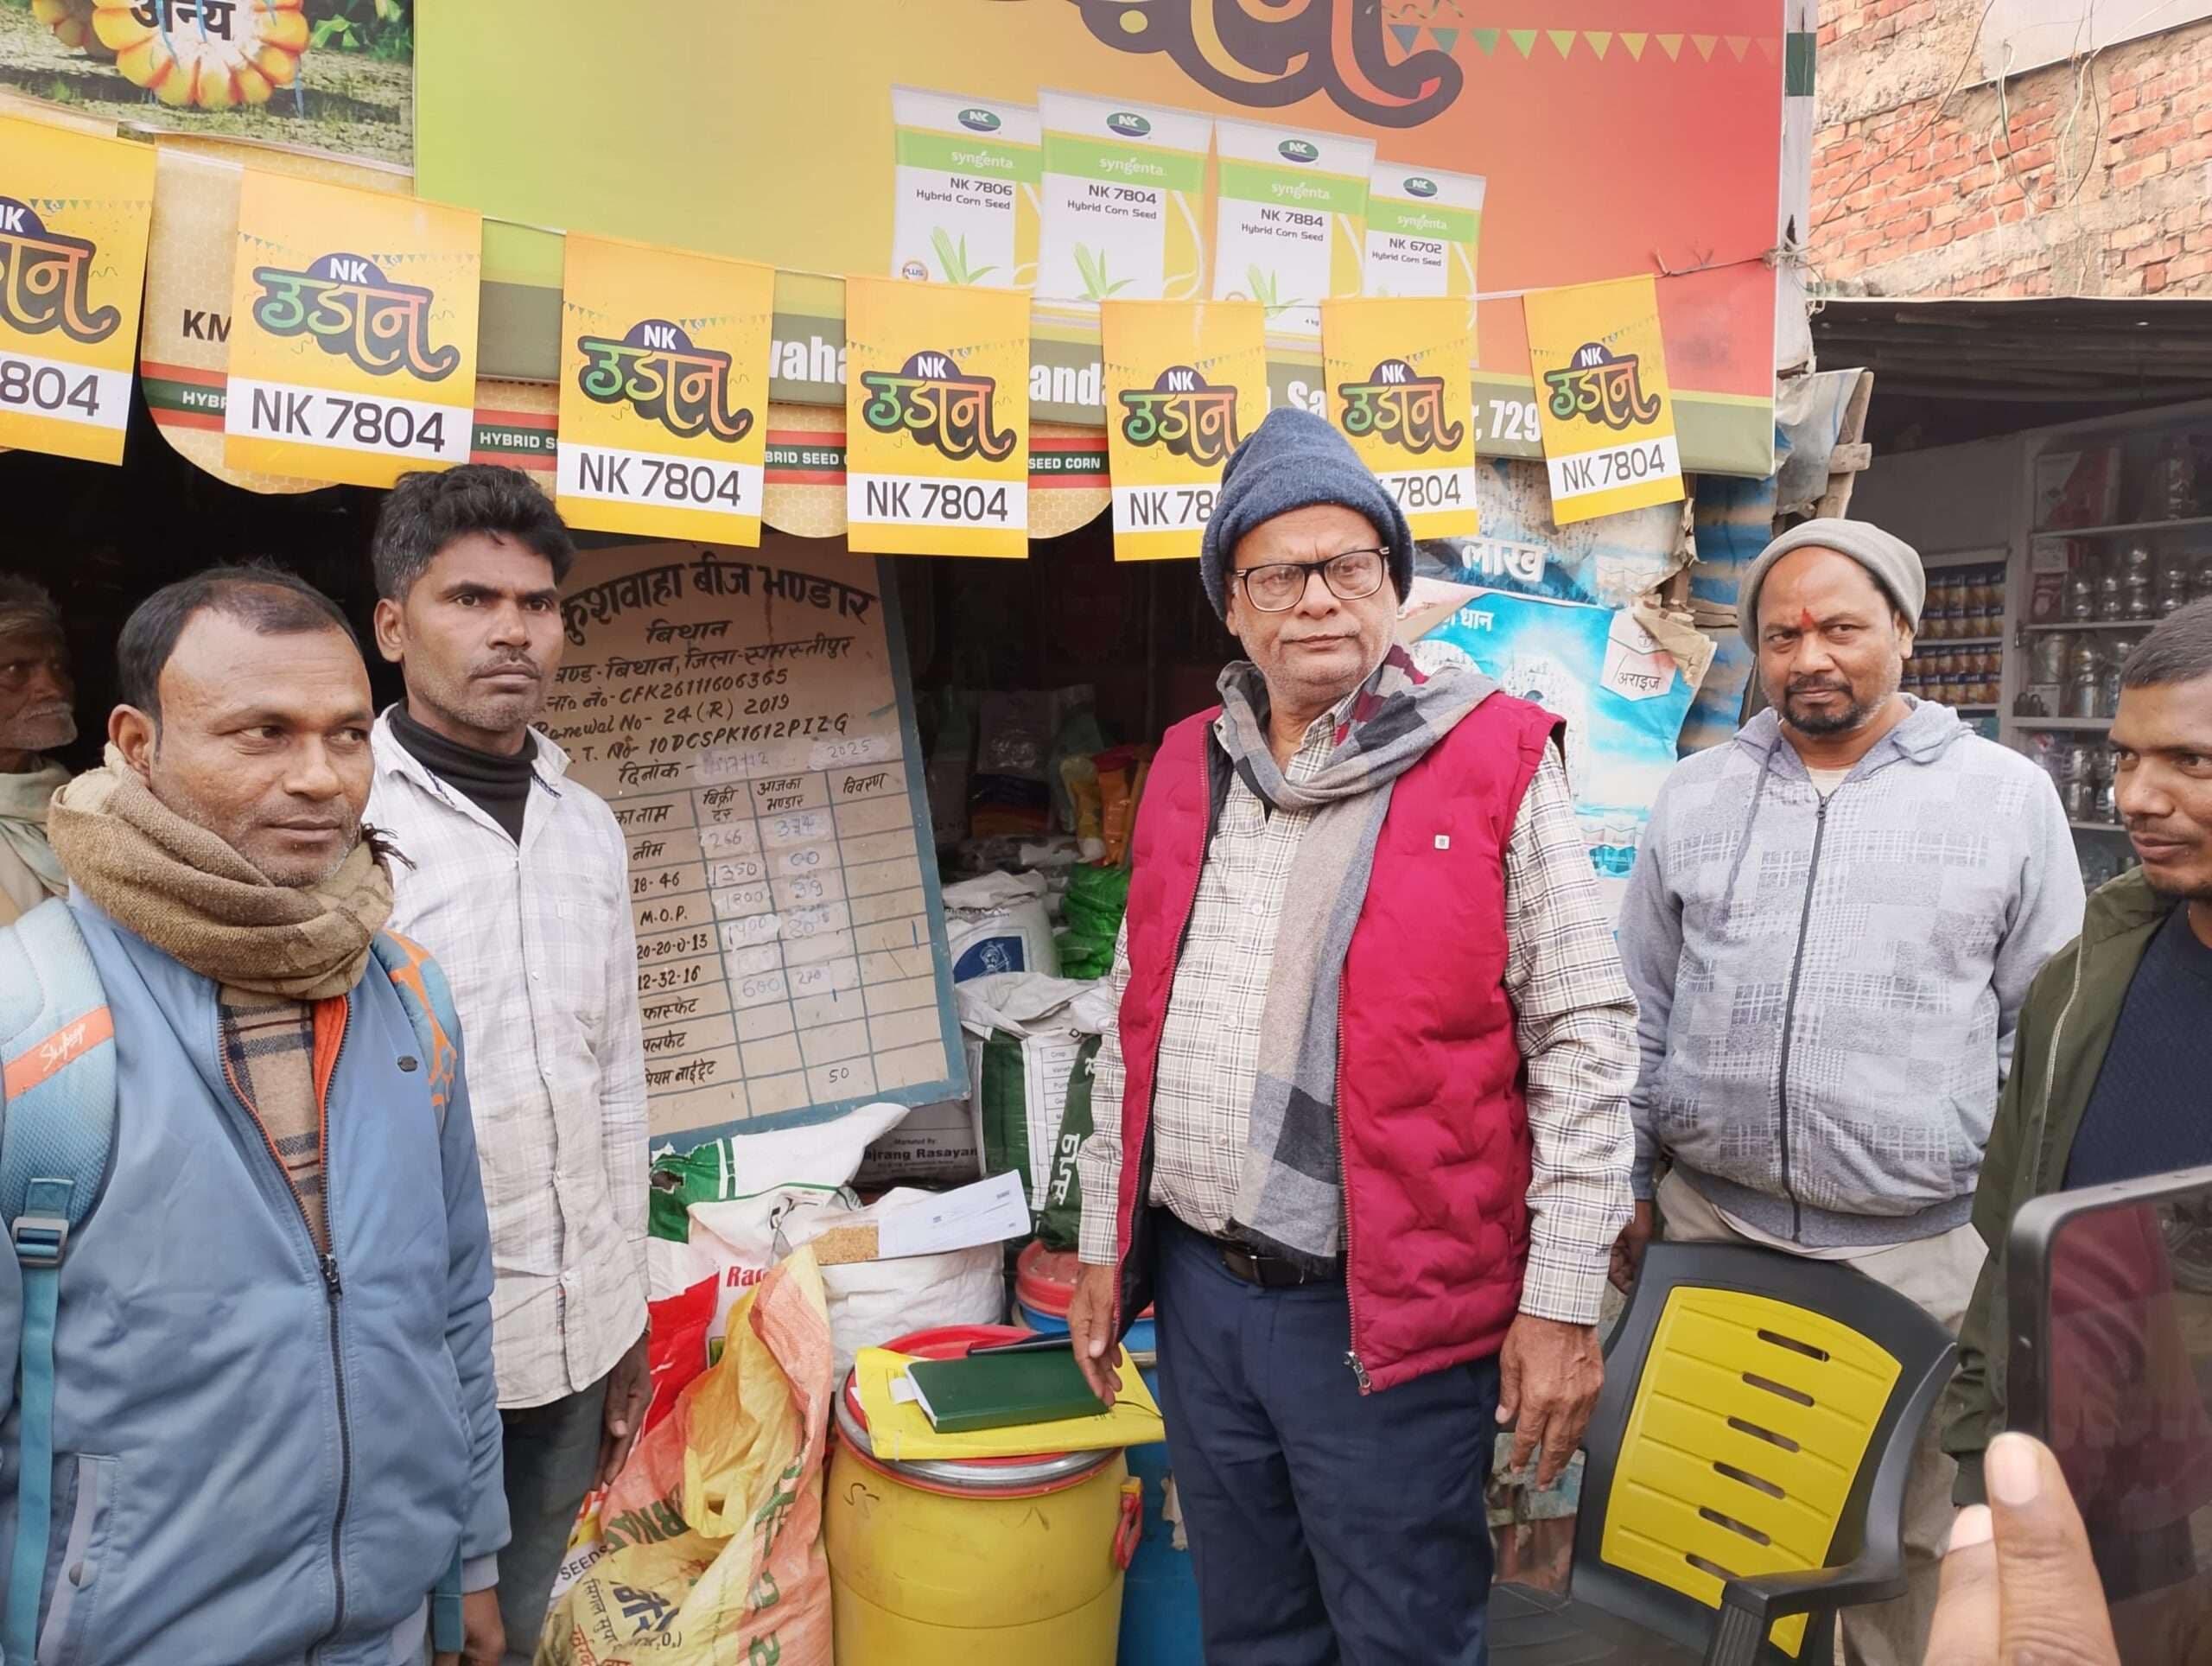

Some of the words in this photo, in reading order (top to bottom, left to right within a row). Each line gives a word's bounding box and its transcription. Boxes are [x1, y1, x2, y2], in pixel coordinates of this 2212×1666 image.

[969, 111, 989, 123] NK
[1117, 114, 1140, 127] NK
[1288, 142, 1308, 154] NK
[951, 150, 1014, 169] syngenta
[1099, 157, 1163, 175] syngenta
[950, 178, 970, 191] NK
[974, 181, 1013, 196] 7806
[1089, 184, 1109, 199] NK
[1113, 188, 1157, 205] 7804
[1271, 181, 1331, 200] syngenta
[916, 189, 952, 202] Hybrid
[956, 194, 981, 207] Corn
[985, 199, 1011, 210] Seed
[1067, 200, 1101, 212] Hybrid
[1104, 204, 1128, 216] Corn
[1132, 208, 1157, 219] Seed
[1261, 208, 1280, 221] NK
[1285, 212, 1324, 227] 7884
[1397, 214, 1447, 230] syngenta
[1241, 224, 1273, 236] Hybrid
[1275, 228, 1298, 238] Corn
[1300, 232, 1324, 242] Seed
[1389, 238, 1406, 250] NK
[1409, 240, 1442, 254] 6702
[1371, 251, 1399, 261] Hybrid
[1401, 254, 1420, 264] Corn
[1422, 258, 1441, 267] Seed
[329, 257, 367, 284] NK
[643, 324, 677, 351] NK
[1580, 347, 1604, 367] NK
[917, 356, 948, 380] NK
[1382, 359, 1407, 384] NK
[1029, 362, 1106, 406] and
[1167, 371, 1195, 391] NK
[251, 387, 314, 438] NK
[325, 397, 446, 453] 7804
[480, 431, 540, 448] HYBRID
[802, 452, 839, 466] SEED
[1028, 457, 1062, 470] SEED
[1065, 458, 1101, 469] CORN
[1561, 456, 1596, 493] NK
[1598, 443, 1665, 485] 7804
[577, 451, 632, 496] NK
[641, 459, 741, 507] 7804
[1390, 474, 1462, 508] 7804
[866, 480, 912, 518] NK
[920, 482, 1009, 523] 7804
[1129, 491, 1169, 526] NK
[1176, 489, 1221, 525] 78
[1462, 537, 1548, 582] लाख
[689, 550, 753, 596] बीज
[757, 564, 879, 626] भण्डार
[645, 618, 733, 645] बिथान
[1617, 672, 1662, 691] अराइज
[743, 693, 790, 715] 2019
[827, 738, 872, 759] 2025
[632, 839, 666, 862] नीम
[638, 964, 701, 991] 12-32-16
[829, 1067, 850, 1084] 50
